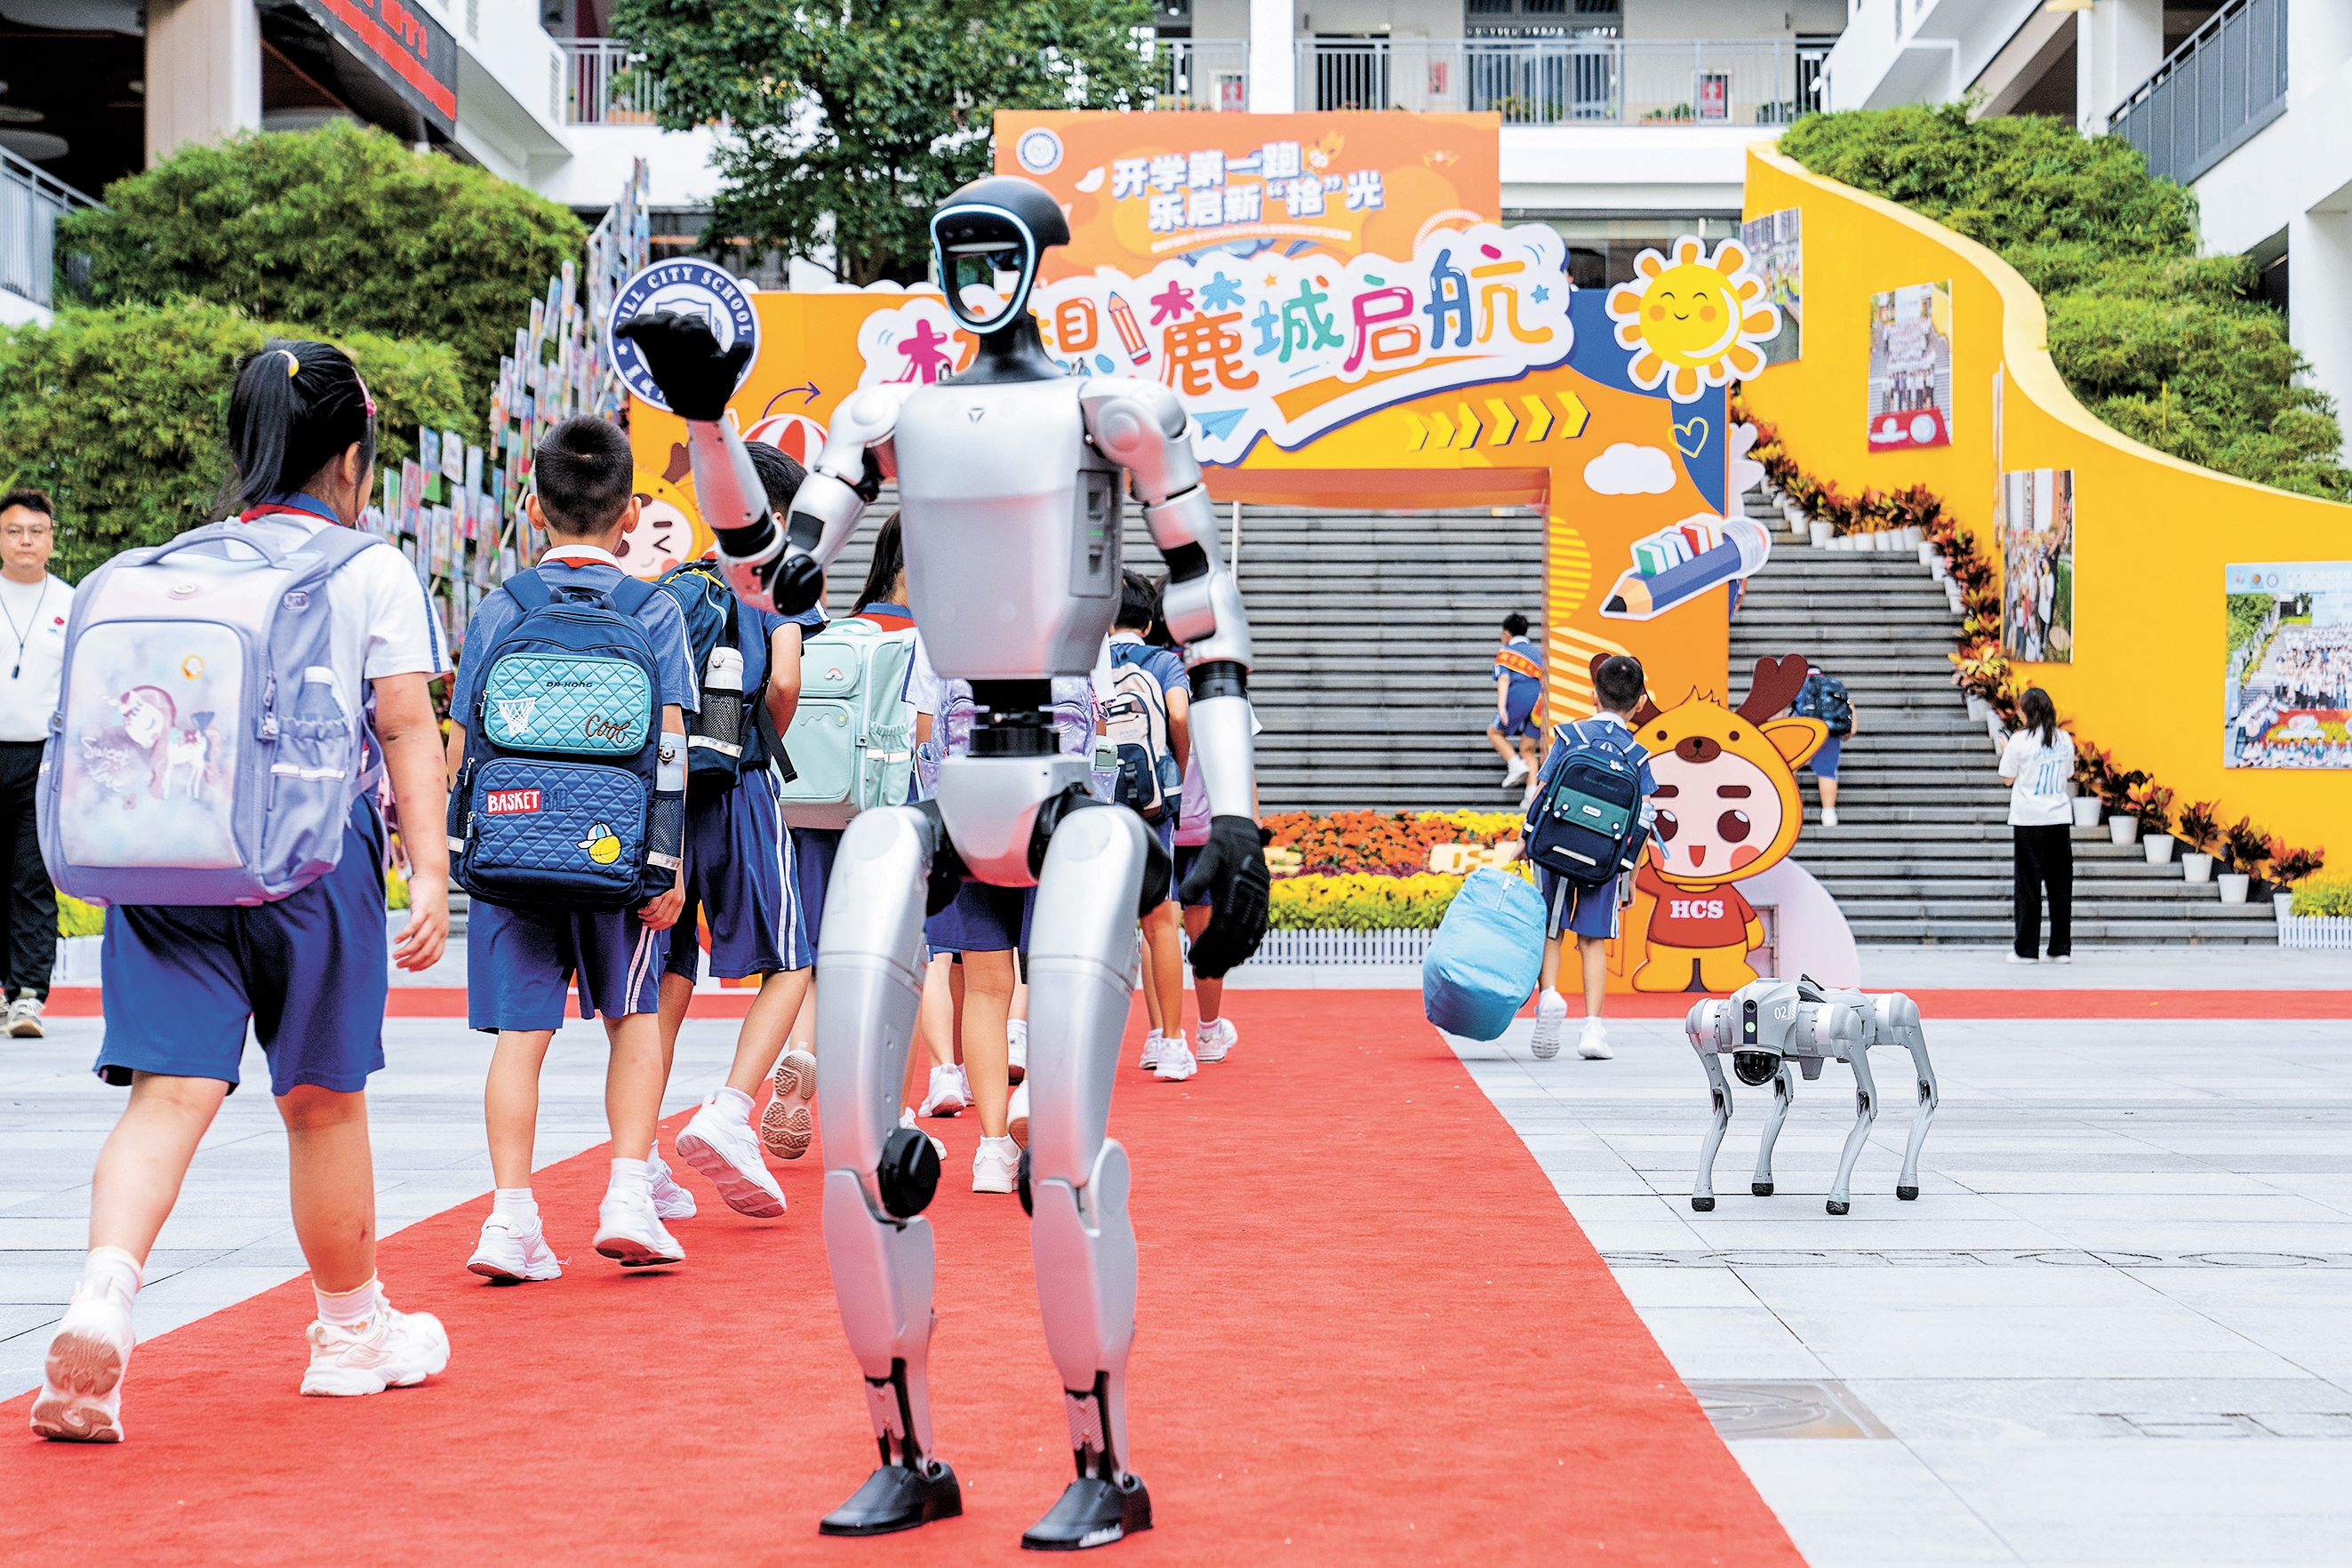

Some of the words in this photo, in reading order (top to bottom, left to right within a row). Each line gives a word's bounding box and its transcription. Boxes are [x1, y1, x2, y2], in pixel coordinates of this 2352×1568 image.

[616, 289, 645, 326] ILL
[646, 267, 693, 290] CITY
[700, 270, 753, 336] SCHOOL
[1149, 244, 1554, 396] 麓城启航
[585, 715, 631, 743] Cool
[488, 791, 540, 812] BASKET
[1670, 900, 1724, 919] HCS
[1773, 1005, 1788, 1020] 02
[1597, 1252, 2352, 1267] SCHOO
